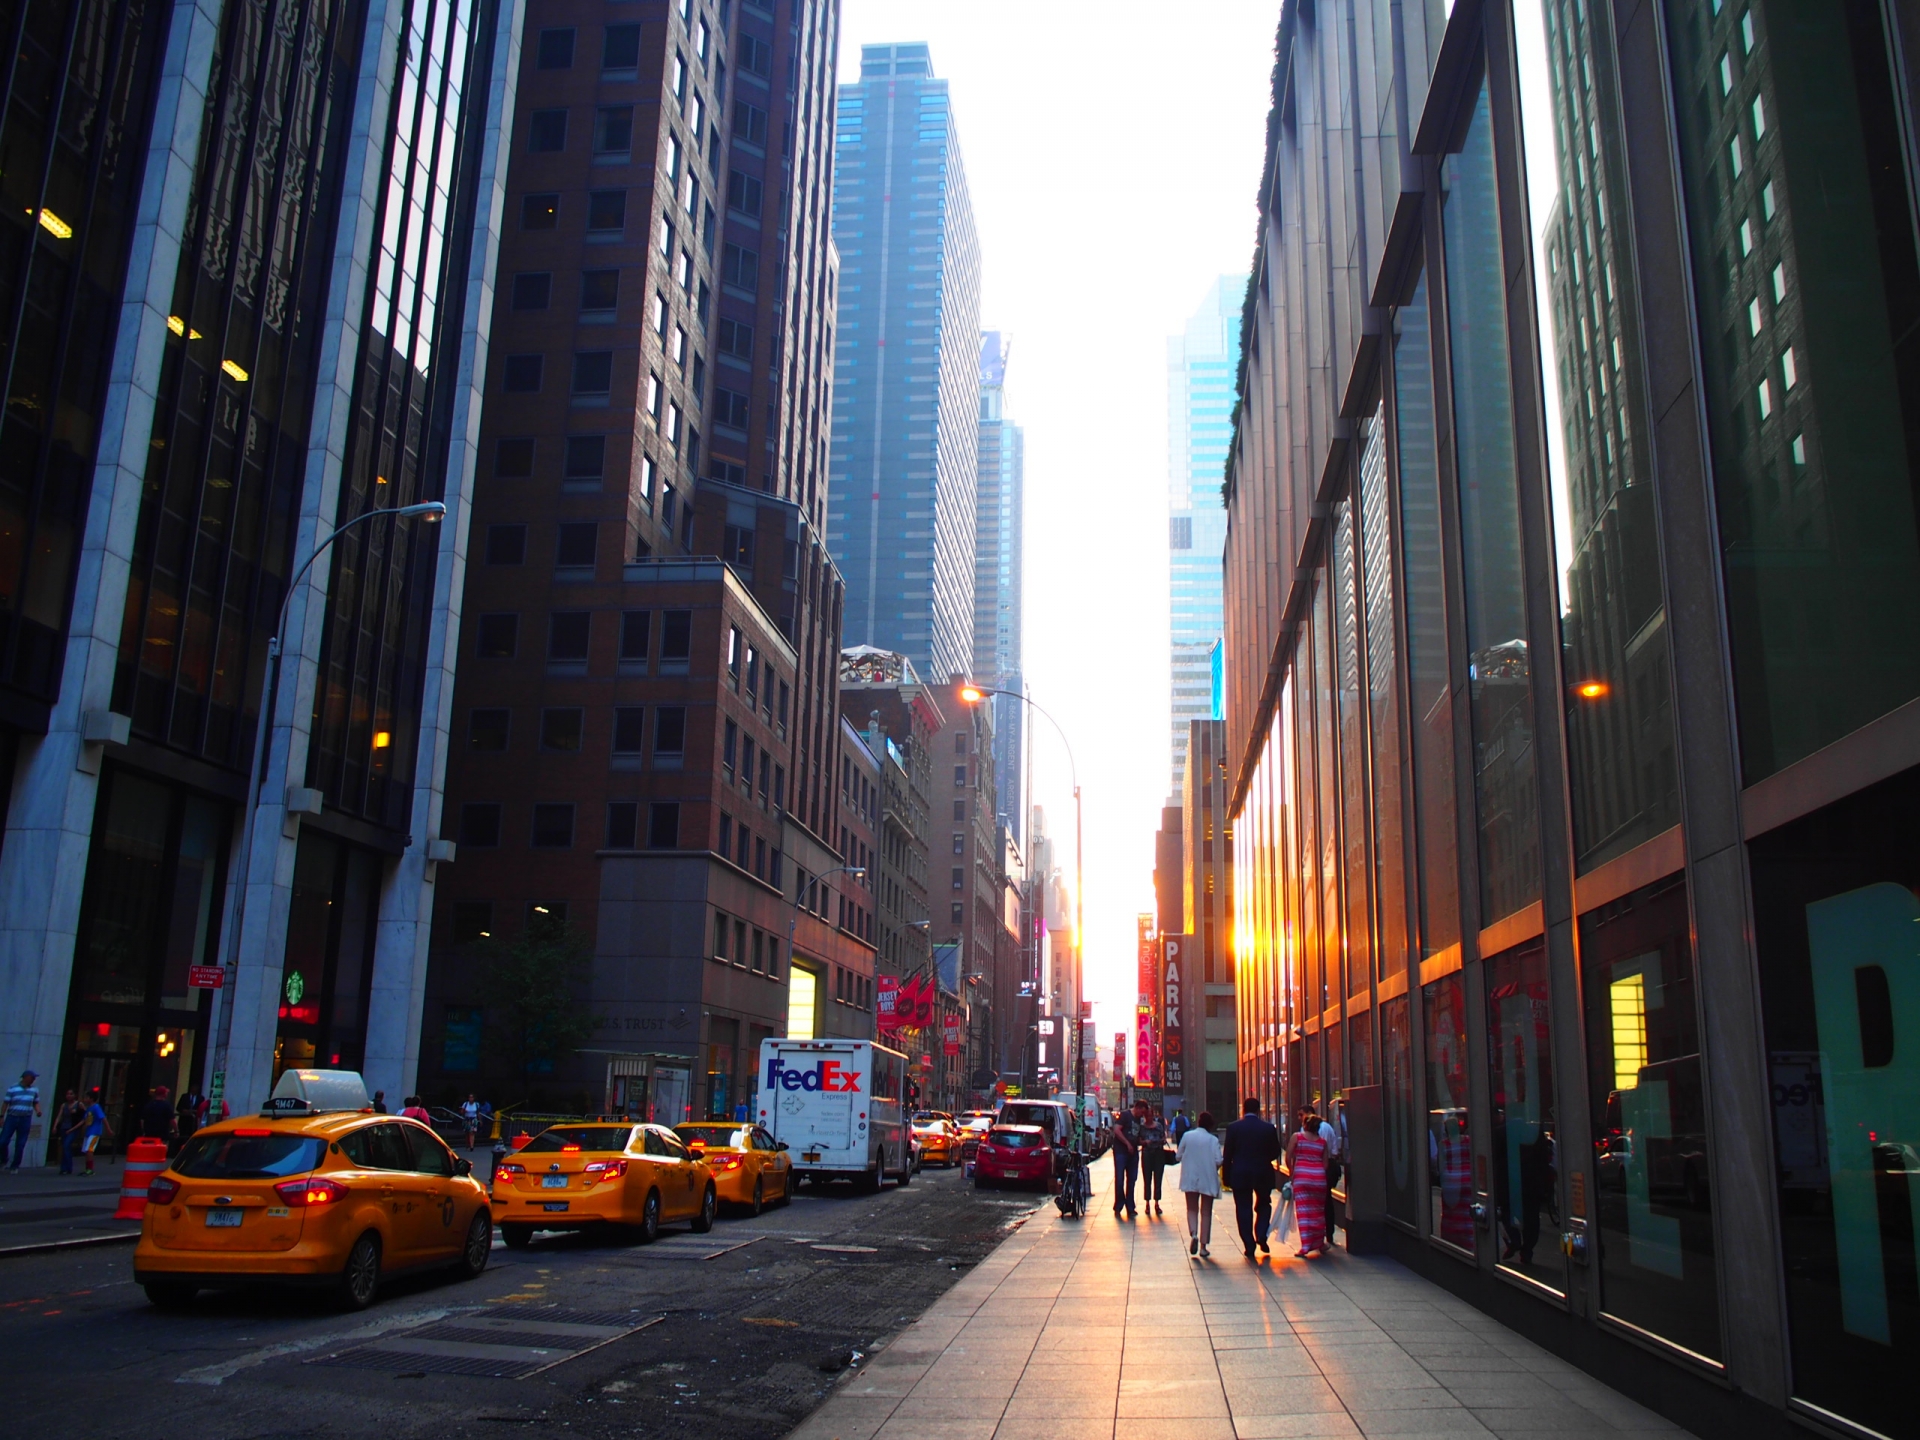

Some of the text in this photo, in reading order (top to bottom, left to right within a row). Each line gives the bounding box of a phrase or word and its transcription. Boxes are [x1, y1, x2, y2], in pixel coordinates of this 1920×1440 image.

[201, 967, 222, 975] STANDING
[1165, 941, 1180, 1028] PARK
[877, 989, 898, 1002] JERSEY
[880, 1002, 895, 1011] BOYS
[625, 1018, 666, 1031] TRUST
[944, 1026, 959, 1034] JERSEY
[947, 1034, 957, 1042] BOYS
[1138, 1014, 1151, 1081] PARK
[767, 1059, 861, 1092] FedEx
[821, 1093, 848, 1101] Express
[274, 1099, 296, 1110] 9M47
